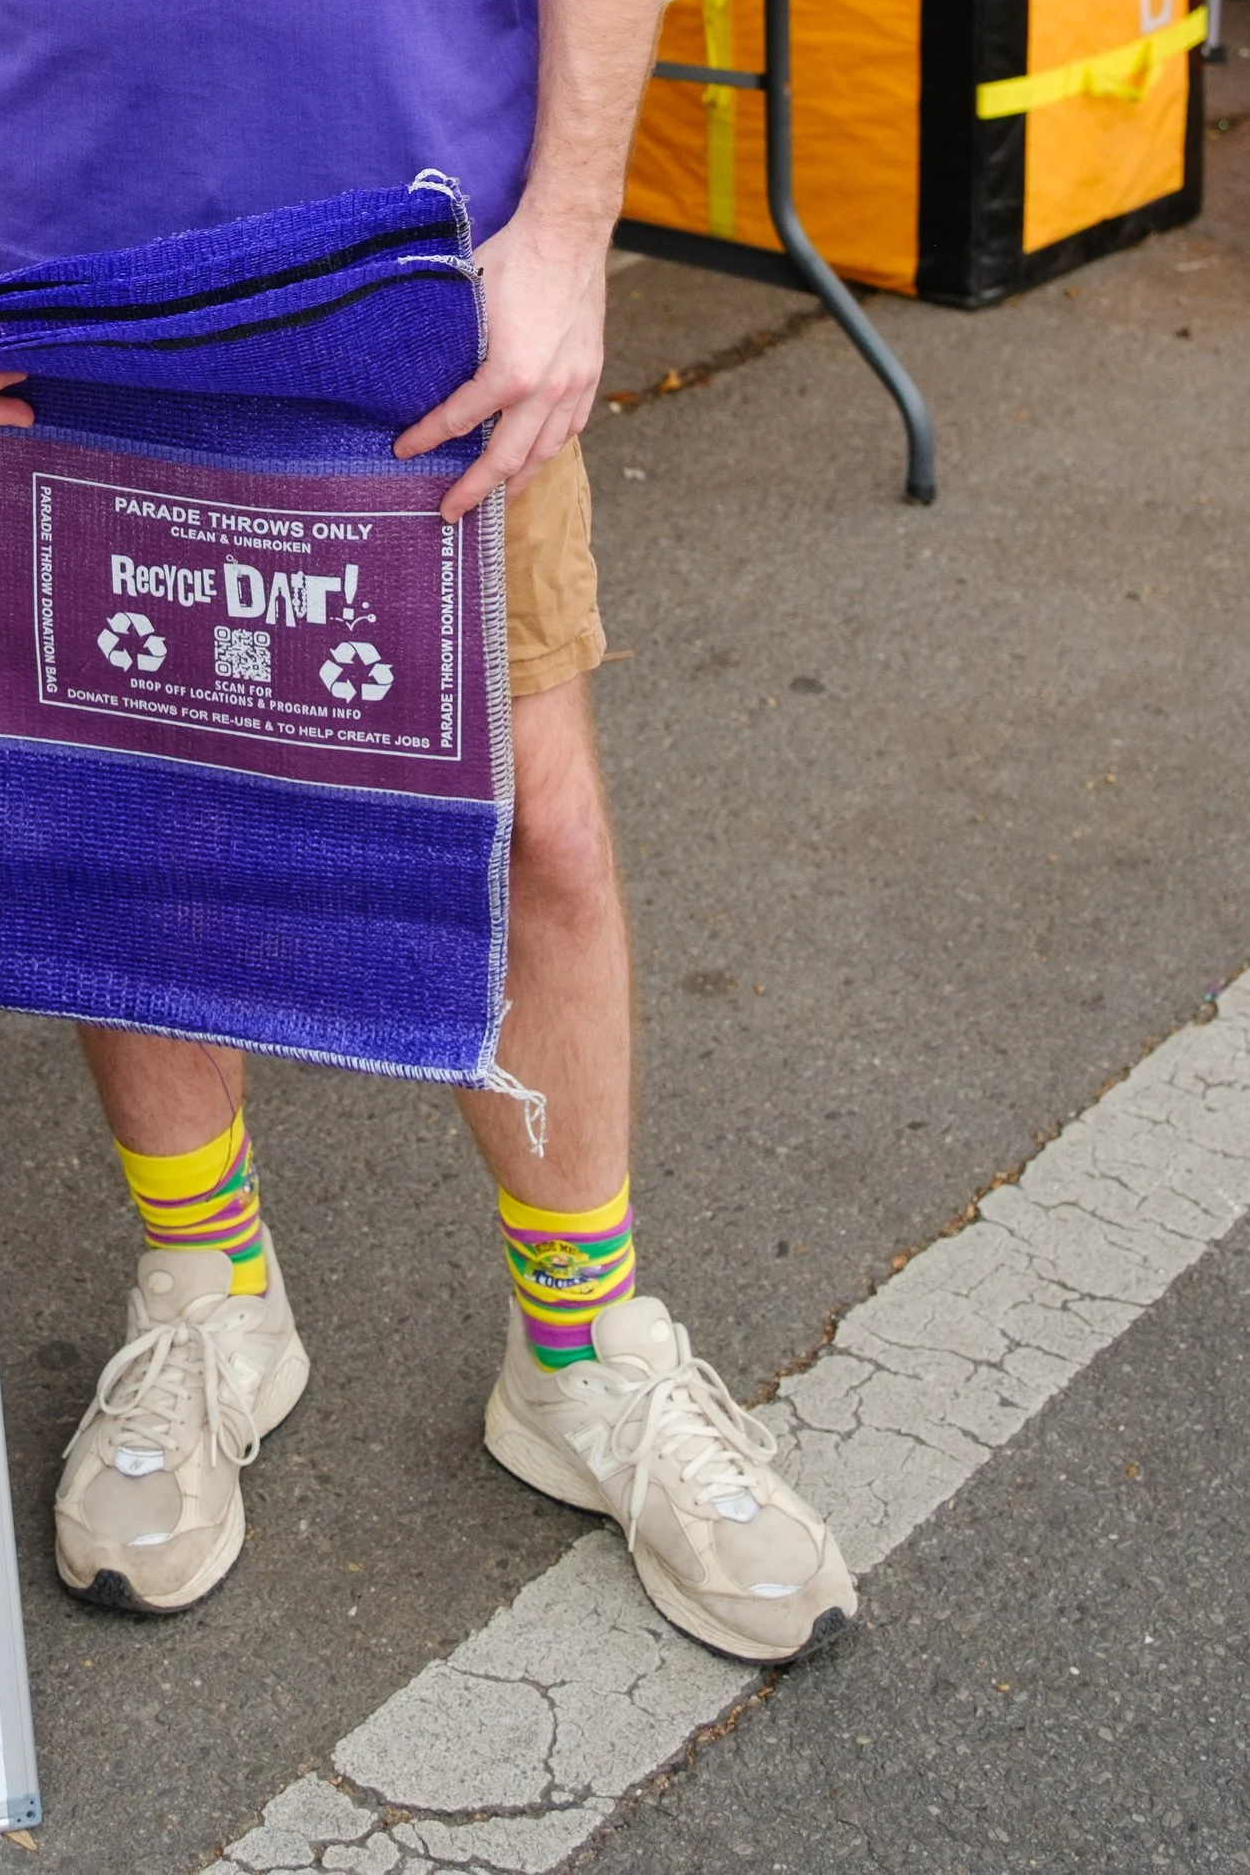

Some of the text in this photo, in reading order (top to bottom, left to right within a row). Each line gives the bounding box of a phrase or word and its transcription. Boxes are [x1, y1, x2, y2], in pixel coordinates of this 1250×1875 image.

[114, 496, 373, 541] PARADE THROWS ONLY
[170, 526, 312, 553] CLEAN & UNBROKEN
[40, 485, 58, 694] PARADE THROW DONATION BAG
[223, 562, 359, 628] DAT!
[440, 525, 455, 749] PARADE THROW DONATION BAG
[130, 677, 362, 720] DROP OFF LOCATIONS & PROGRAM INFO
[214, 679, 272, 698] SCAN FOR
[67, 688, 431, 750] DONATE THROWS FOR RE-USE & TO HELP CREATE JOBS
